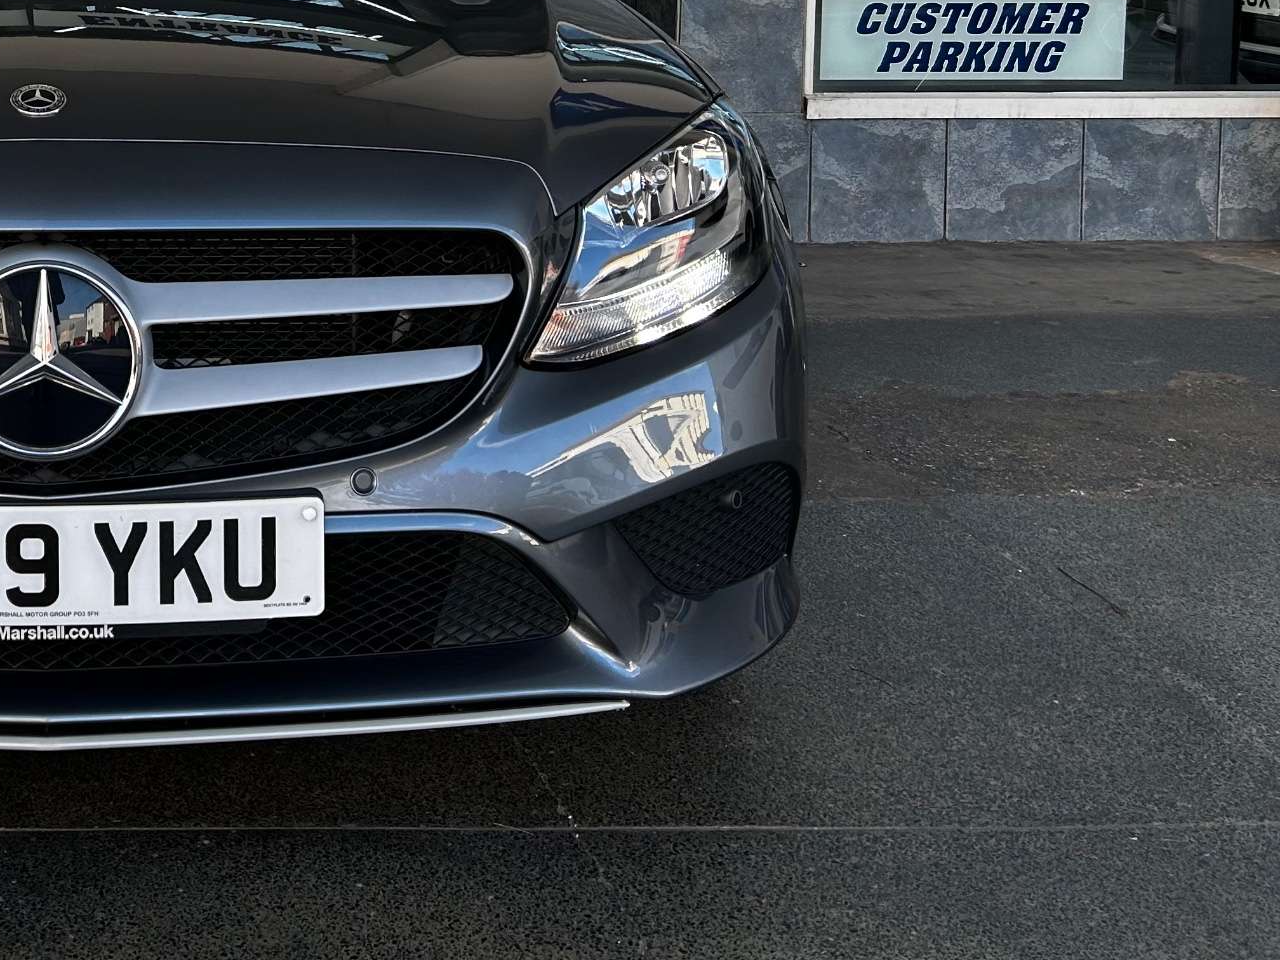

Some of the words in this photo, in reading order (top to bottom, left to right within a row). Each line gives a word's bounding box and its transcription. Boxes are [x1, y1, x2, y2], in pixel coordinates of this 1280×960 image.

[856, 2, 1090, 35] CUSTOMER
[876, 41, 1067, 73] PARKING
[93, 516, 277, 607] YKU
